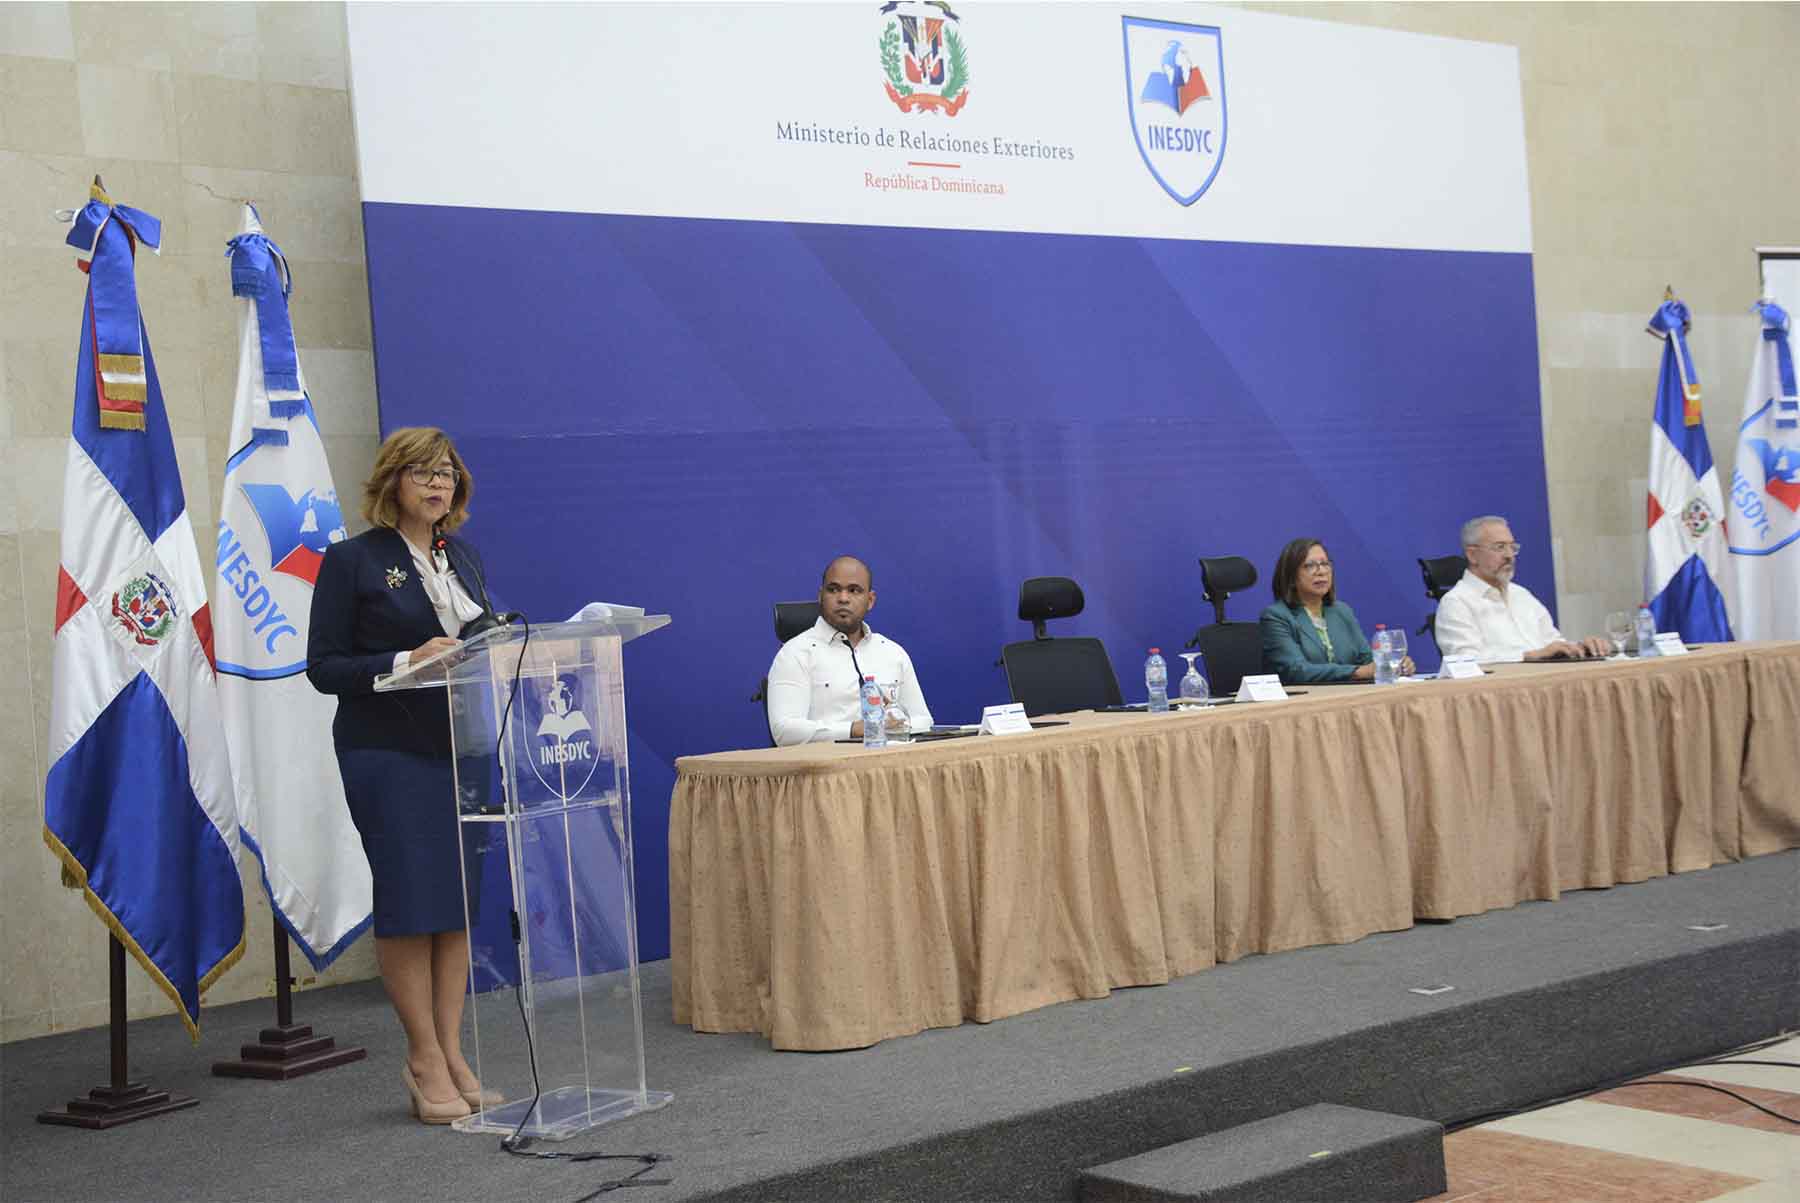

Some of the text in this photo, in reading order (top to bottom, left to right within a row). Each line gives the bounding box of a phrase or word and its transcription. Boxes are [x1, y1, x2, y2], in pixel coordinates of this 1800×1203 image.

[776, 120, 1075, 161] Ministerio de Relaciones Exteriores
[1148, 124, 1212, 154] INESDYC
[864, 171, 1004, 195] República Dominicana
[540, 740, 592, 765] INESDYC
